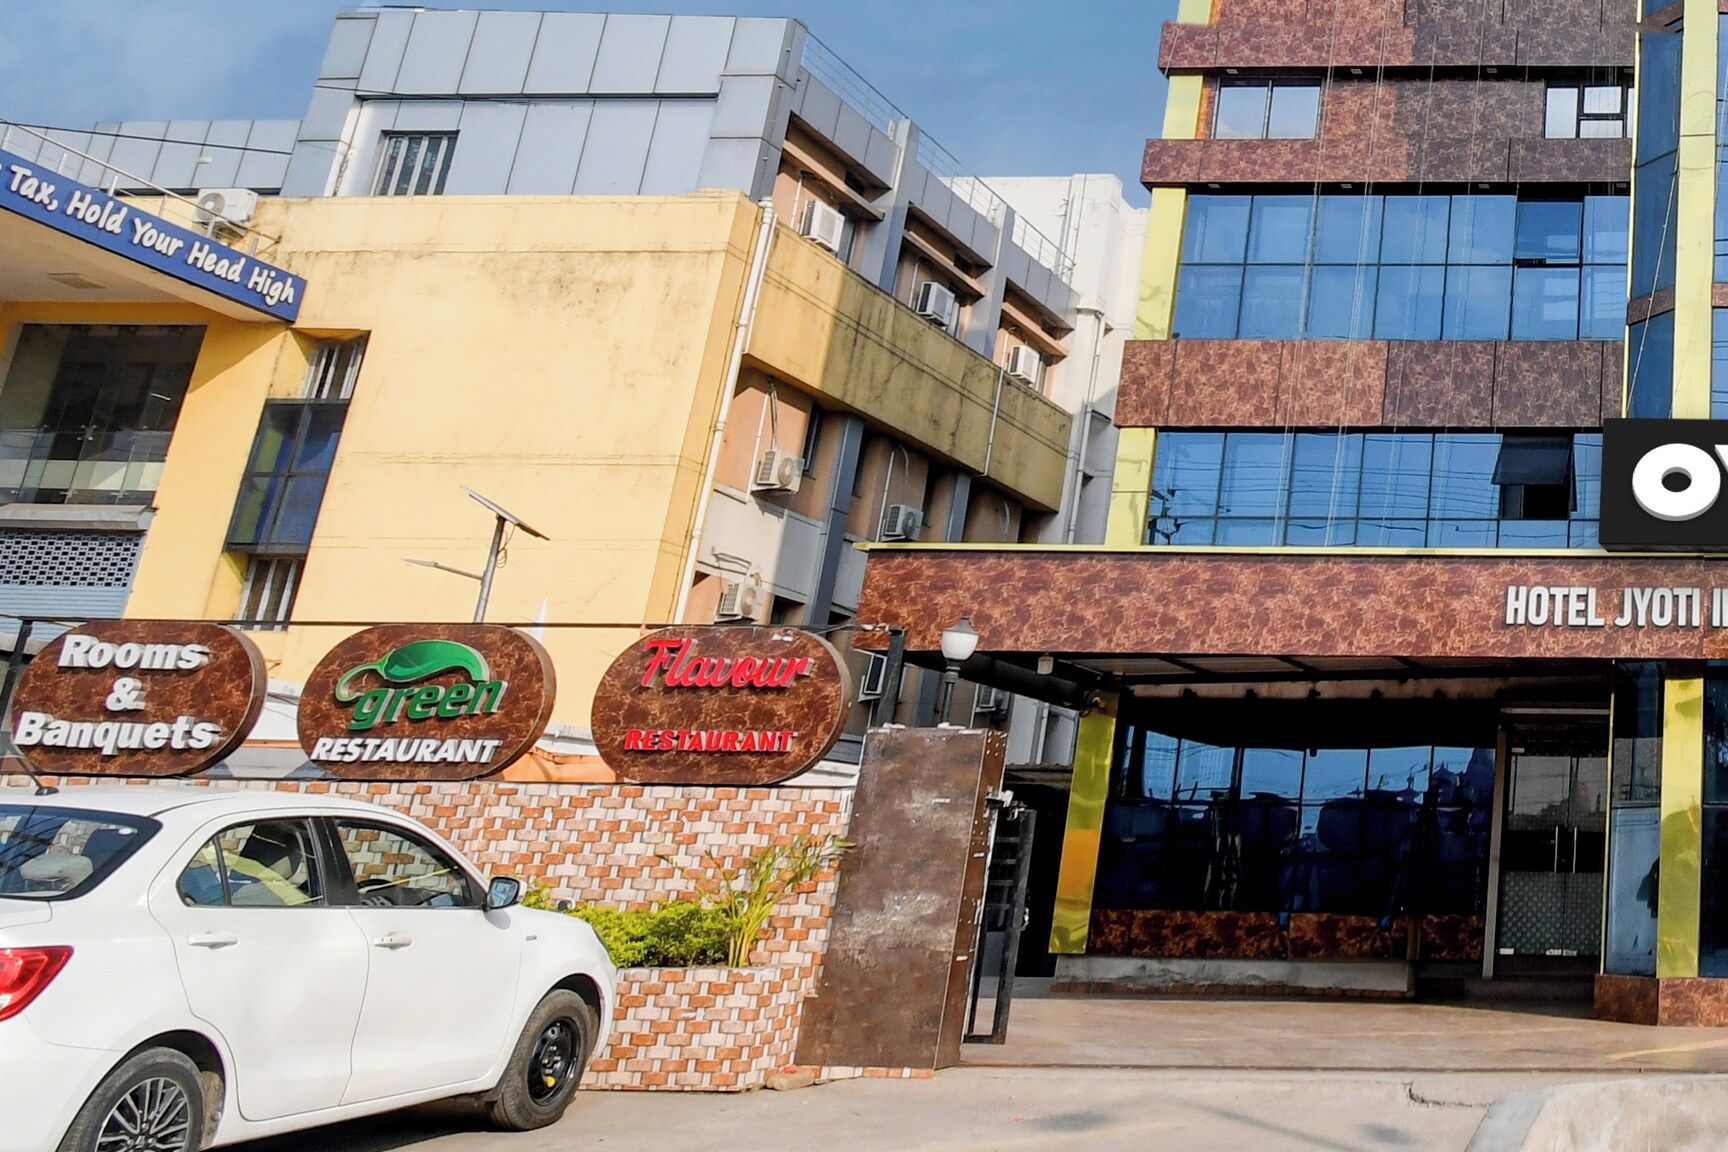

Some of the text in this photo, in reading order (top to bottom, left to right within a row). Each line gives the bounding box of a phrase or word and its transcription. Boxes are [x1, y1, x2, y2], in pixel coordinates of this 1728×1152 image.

[10, 164, 295, 306] Tax, Hold Your Head High
[1505, 586, 1605, 627] HOTEL
[1614, 586, 1701, 628] JYOTI
[57, 634, 209, 670] Rooms
[638, 637, 813, 689] Flavour
[105, 677, 145, 711] &
[347, 680, 508, 730] green
[14, 711, 219, 755] Banquets
[309, 737, 502, 764] RESTAURANT
[623, 730, 799, 753] RESTAURANT
